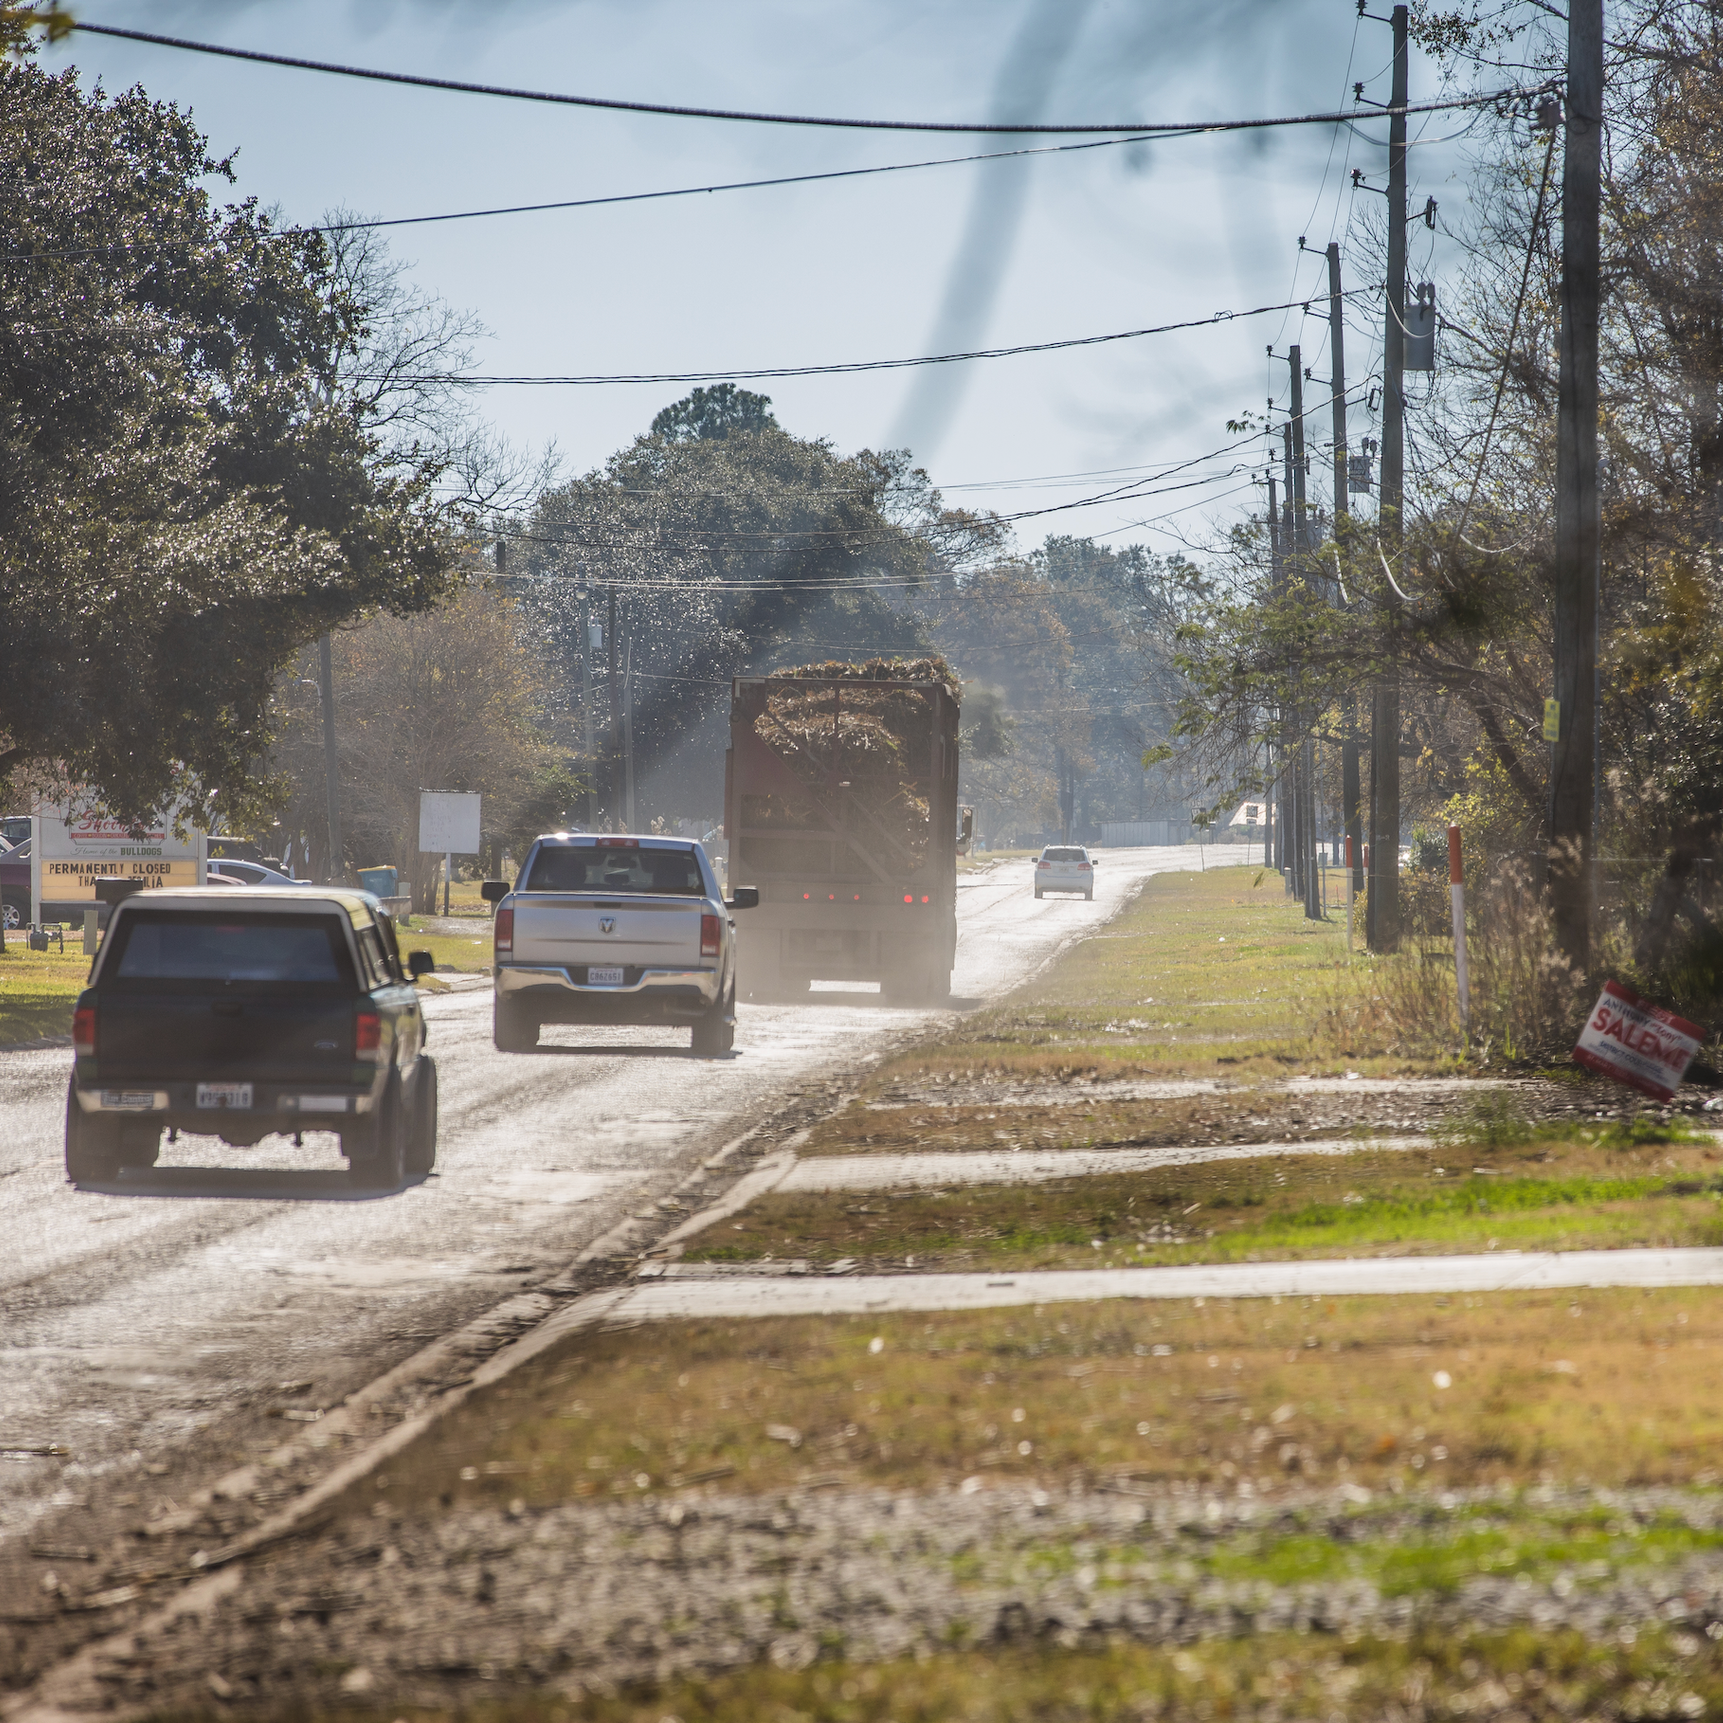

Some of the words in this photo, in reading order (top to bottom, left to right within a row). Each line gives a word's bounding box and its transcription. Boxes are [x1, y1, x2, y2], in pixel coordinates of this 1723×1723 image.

[120, 847, 162, 856] BULLDOGS
[50, 863, 124, 874] PERMANENTLY
[132, 863, 171, 874] CLOSED
[1603, 997, 1651, 1028] ANTHONY
